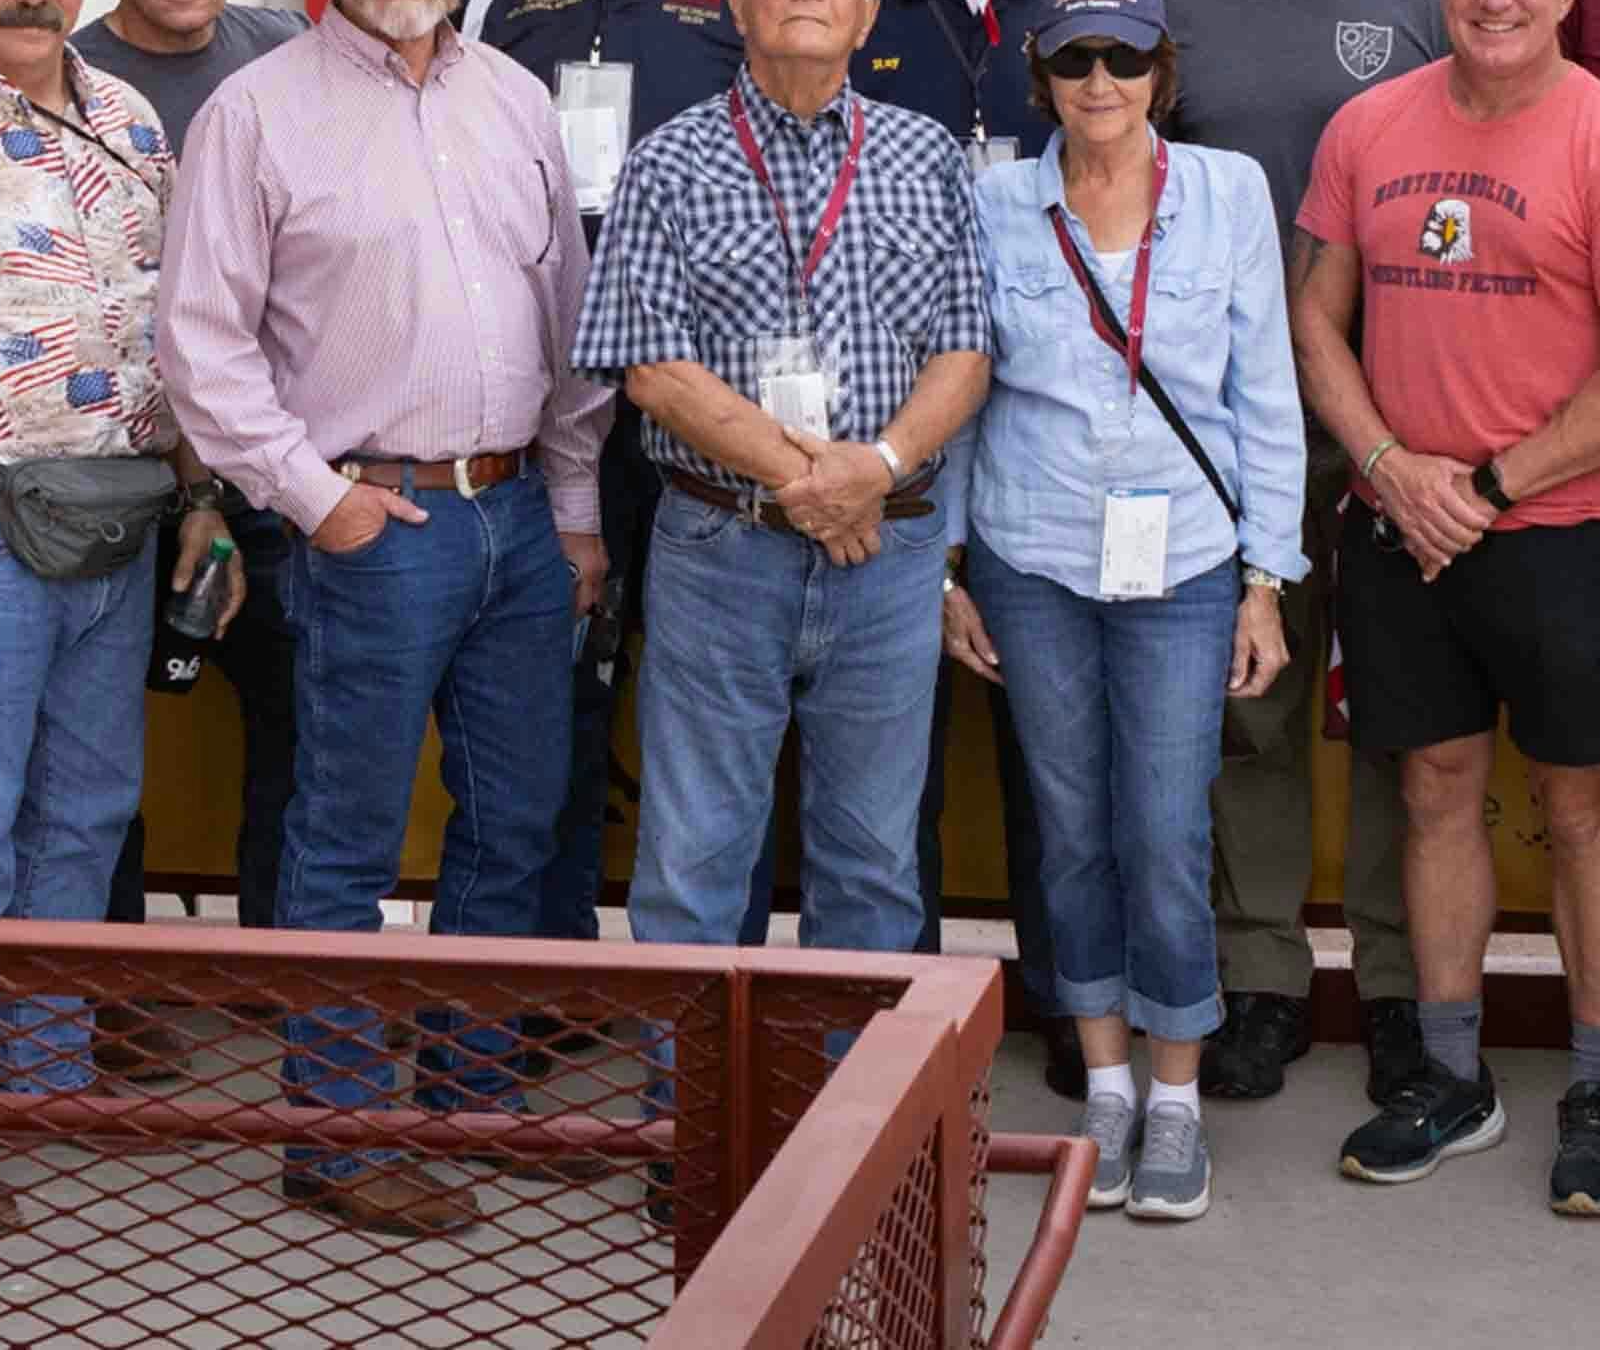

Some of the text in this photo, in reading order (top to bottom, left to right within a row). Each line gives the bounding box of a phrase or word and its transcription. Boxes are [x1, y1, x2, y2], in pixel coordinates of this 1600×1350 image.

[1373, 171, 1526, 222] NORTH CAROLINA
[1458, 271, 1537, 296] FACTORY
